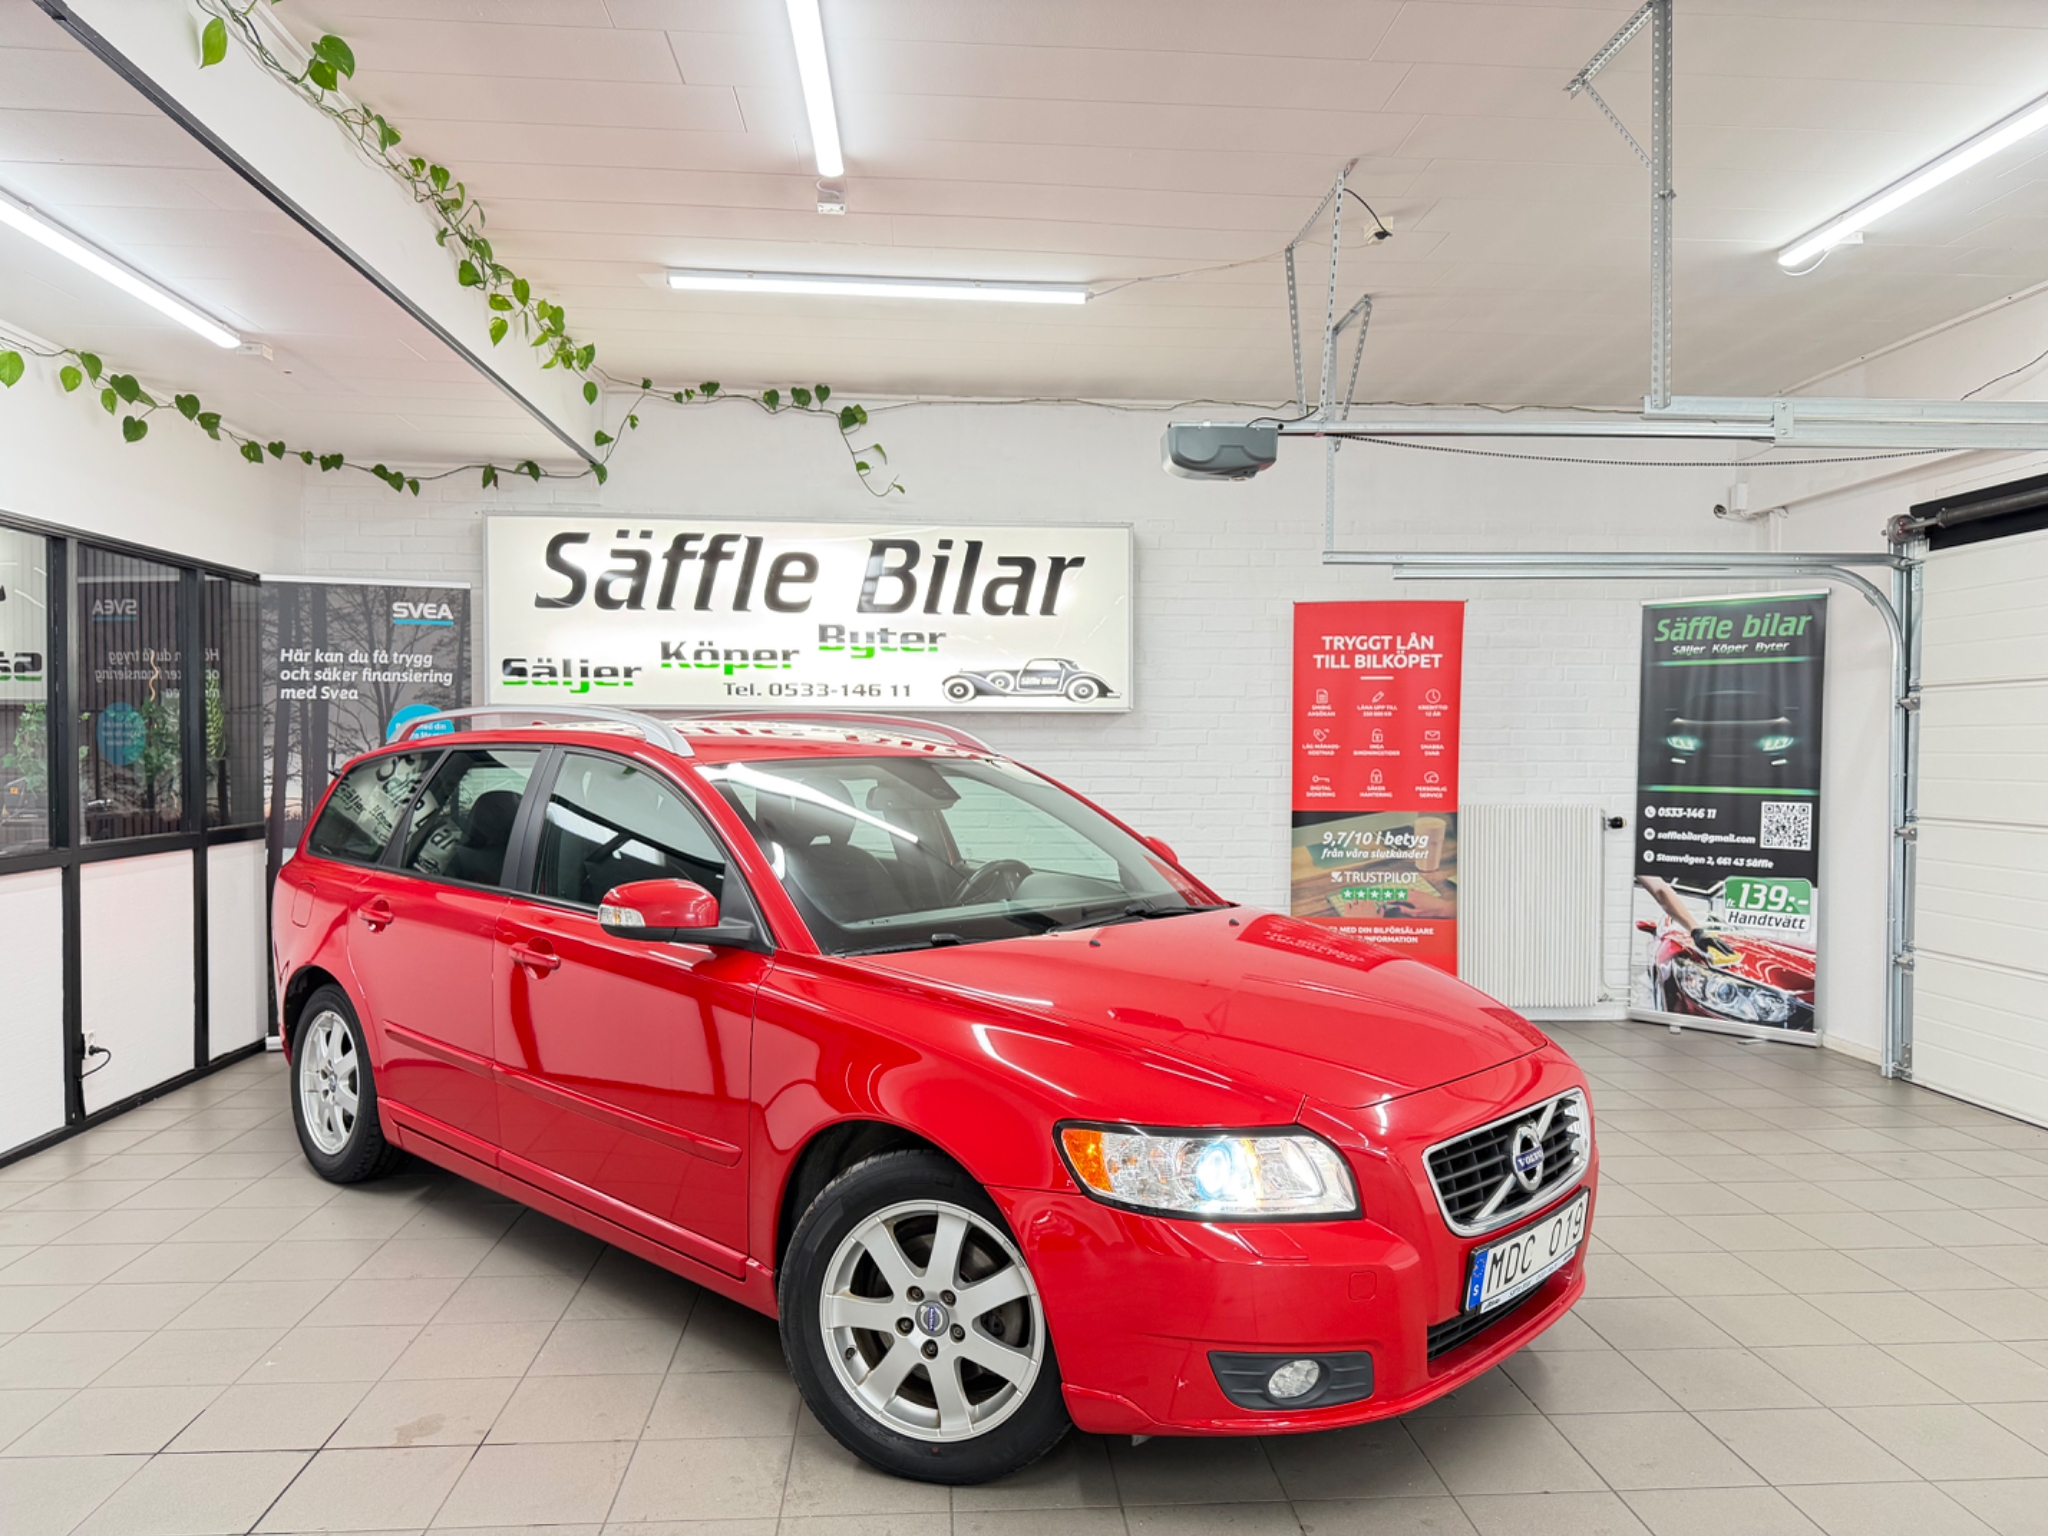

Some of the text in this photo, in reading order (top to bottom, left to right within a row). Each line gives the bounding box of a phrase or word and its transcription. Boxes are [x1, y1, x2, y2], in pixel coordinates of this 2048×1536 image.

[535, 529, 1085, 616] Säffle Bilar
[392, 602, 454, 619] SVEA
[1654, 612, 1812, 642] Säffle bilar
[818, 624, 947, 659] Byter
[1321, 632, 1434, 650] TRYGGT LÅN
[1672, 641, 1790, 656] Säljer Köper Byter
[280, 648, 433, 668] Här kan du få trygg
[660, 641, 800, 675] Köper
[1313, 650, 1443, 669] TILL BILKÖPET
[280, 667, 453, 687] och säker finansiering
[502, 657, 642, 694] Säljer
[280, 685, 359, 700] med Svea
[723, 683, 911, 697] Tel. 0533-146 11
[1658, 807, 1717, 819] 0533-146 11
[1322, 831, 1429, 849] 9,7/10 i betyg
[1346, 849, 1369, 859] våra
[1371, 849, 1429, 859] slutkunder!
[1344, 872, 1419, 883] TRUSTPILOT
[1738, 883, 1809, 912] 139:-
[1340, 926, 1357, 934] MED
[1358, 926, 1372, 934] DIN
[1373, 925, 1434, 935] BILFÖRSÄLJARE
[1728, 911, 1807, 930] Handtvätt
[1518, 1149, 1544, 1168] VOLVO
[1472, 1202, 1584, 1297] S MDC 019
